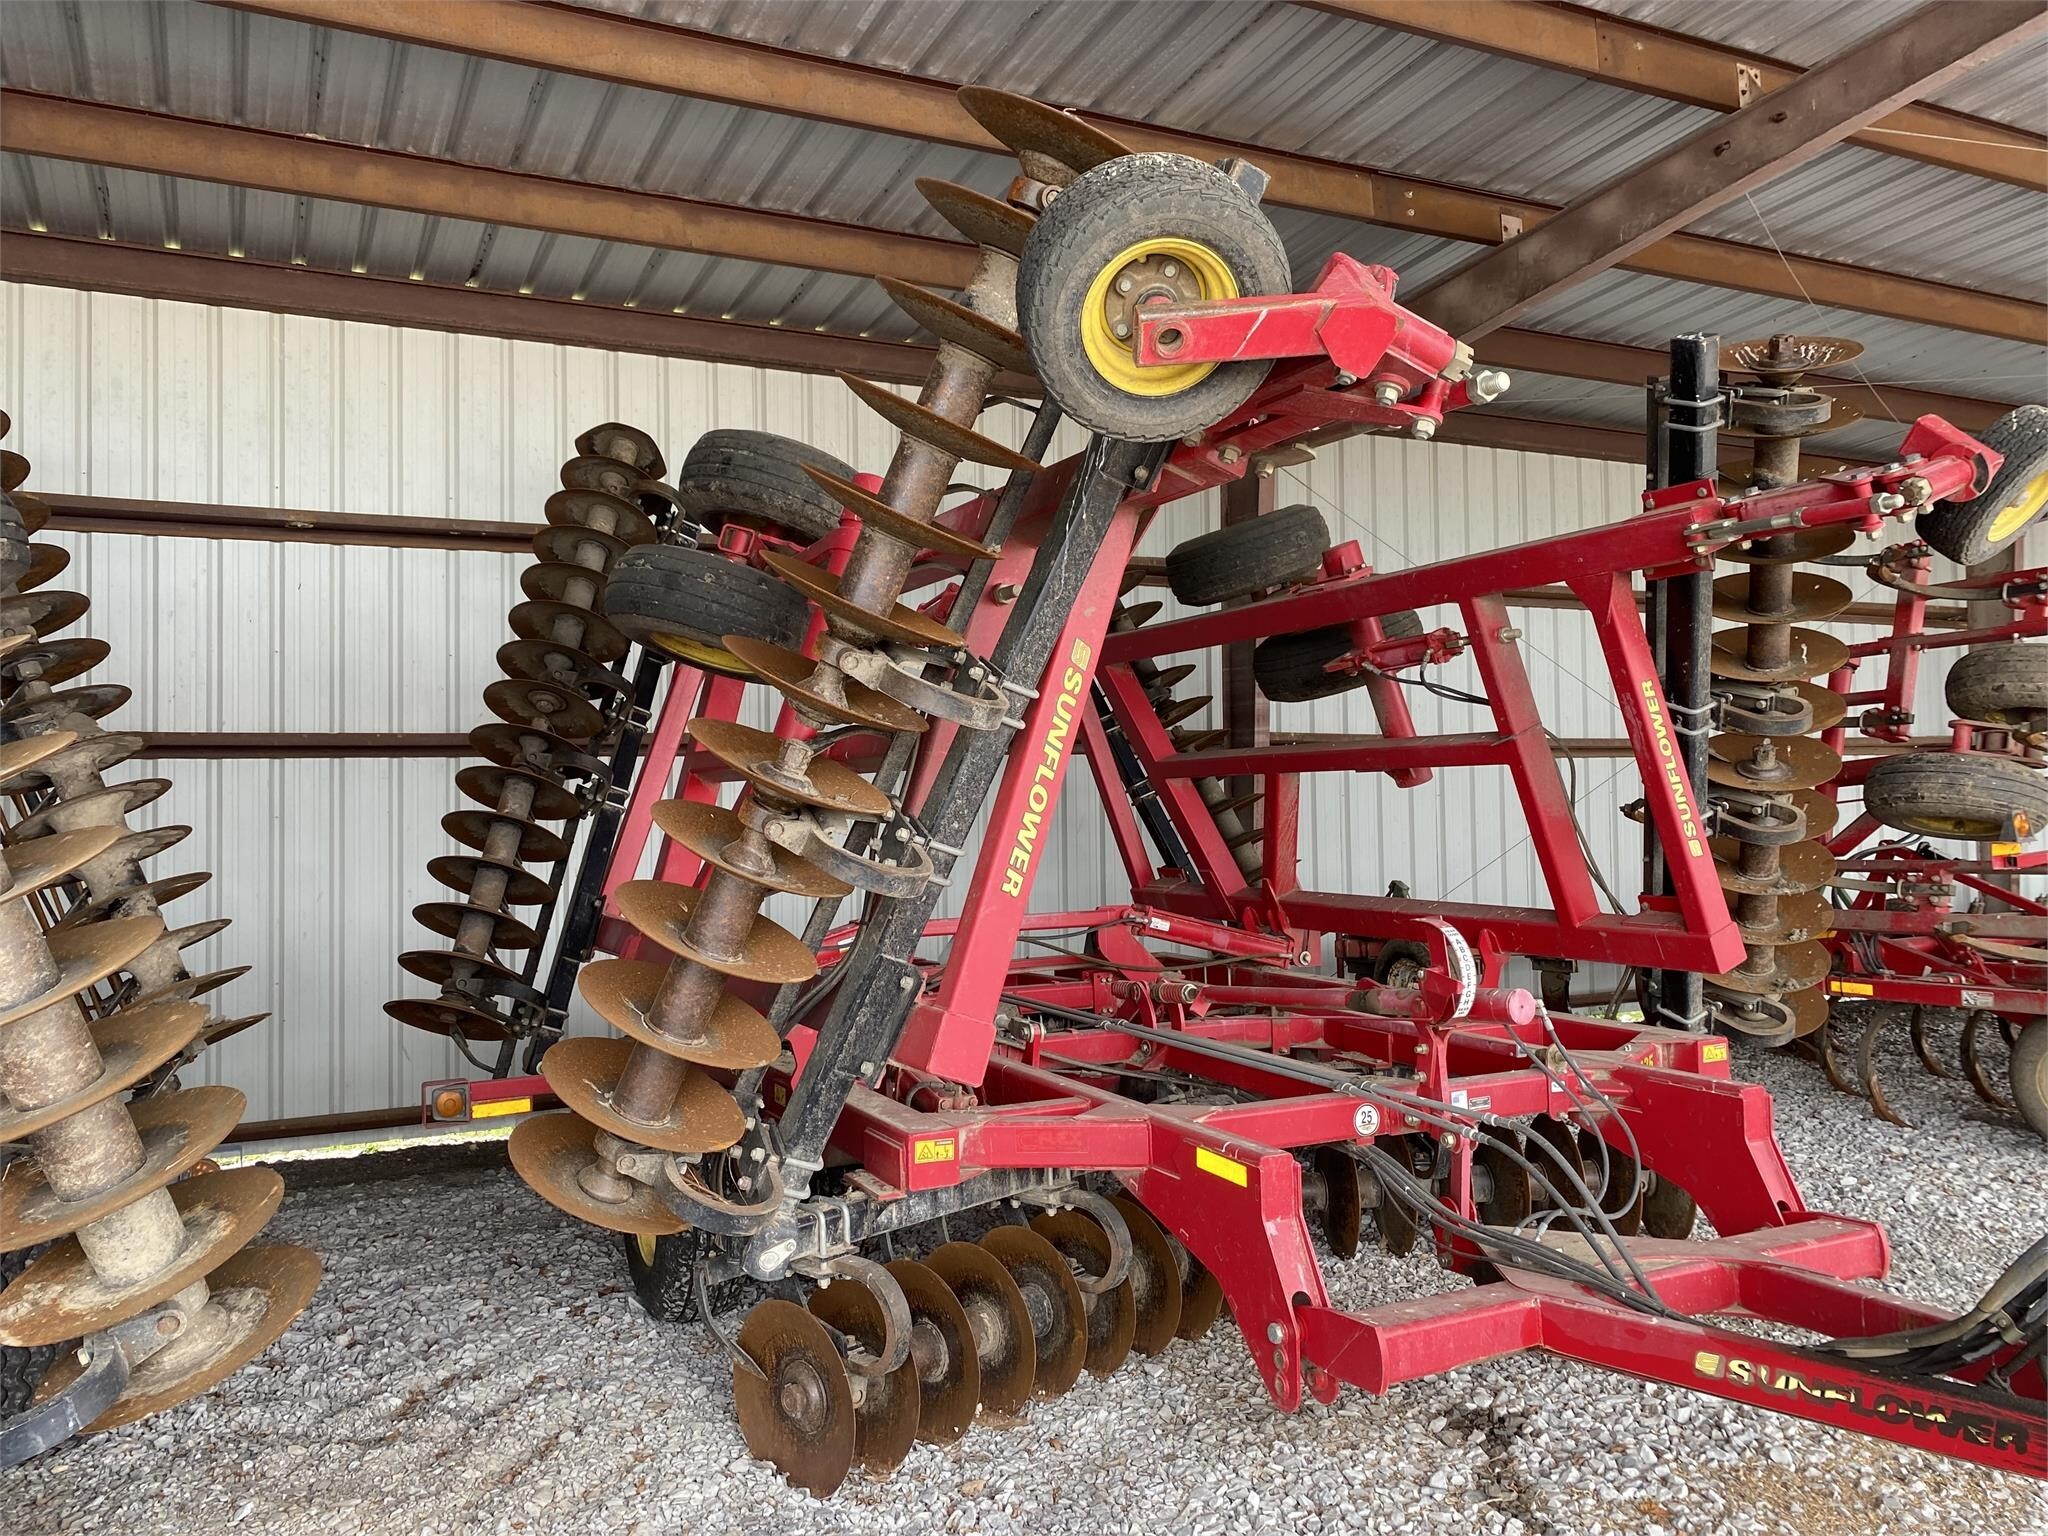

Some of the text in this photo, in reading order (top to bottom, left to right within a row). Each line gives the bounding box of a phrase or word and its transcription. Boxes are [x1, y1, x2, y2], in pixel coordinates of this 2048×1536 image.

[1001, 666, 1084, 898] SUNFLOWER
[1641, 679, 1697, 838] SUNFLOWER
[1361, 1110, 1373, 1124] 25
[1727, 1357, 2031, 1455] SUNFLOWER
